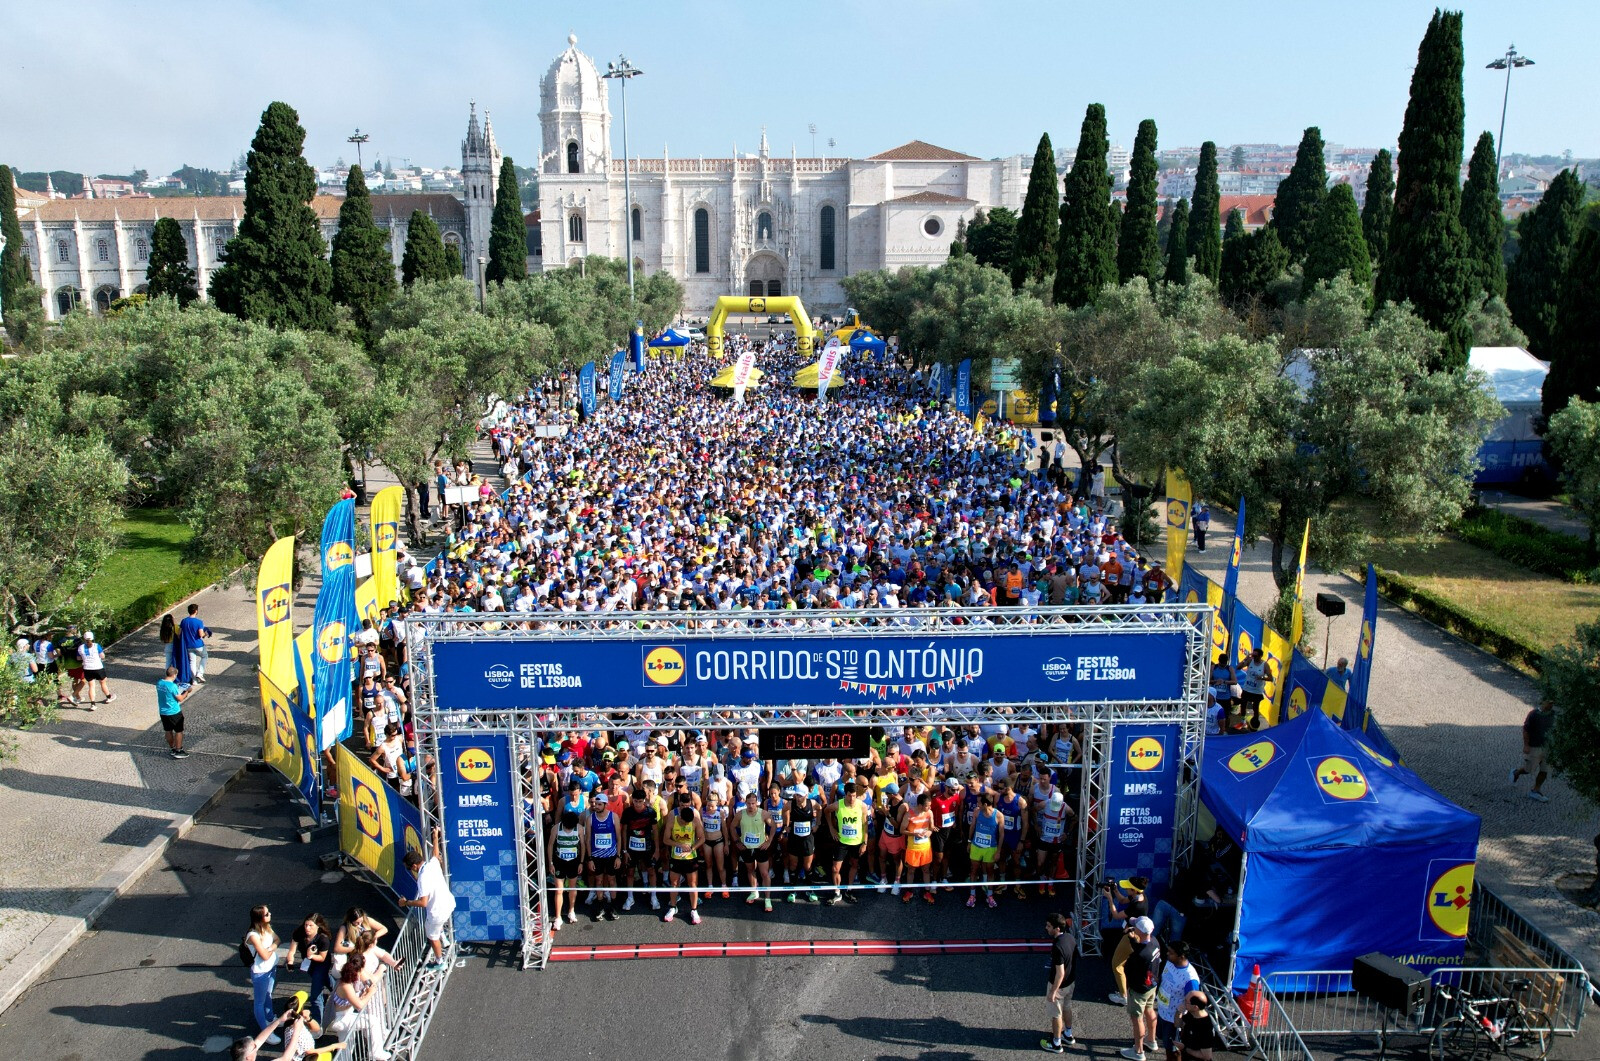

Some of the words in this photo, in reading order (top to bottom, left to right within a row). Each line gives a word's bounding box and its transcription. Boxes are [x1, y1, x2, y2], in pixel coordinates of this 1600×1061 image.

[735, 354, 752, 385] Vitalis
[818, 349, 837, 381] Vitalis
[813, 652, 823, 663] DE
[1077, 656, 1119, 669] FESTAS
[520, 663, 563, 676] FESTAS
[1042, 663, 1072, 671] LISBOA
[484, 670, 515, 679] LISBOA
[1076, 669, 1091, 681] DE
[1094, 668, 1136, 680] LISBOA
[520, 676, 535, 689] DE
[538, 675, 582, 688] LISBOA
[785, 733, 852, 749] 0:00:00
[1124, 782, 1157, 795] HMS
[458, 794, 493, 807] HMS
[1120, 807, 1150, 816] FESTAS
[457, 819, 489, 829] FESTAS
[1119, 816, 1131, 825] DE
[1132, 815, 1162, 825] LISBOA
[458, 828, 469, 838] DE
[471, 827, 503, 838] LISBOA
[459, 844, 486, 852] LISBOA
